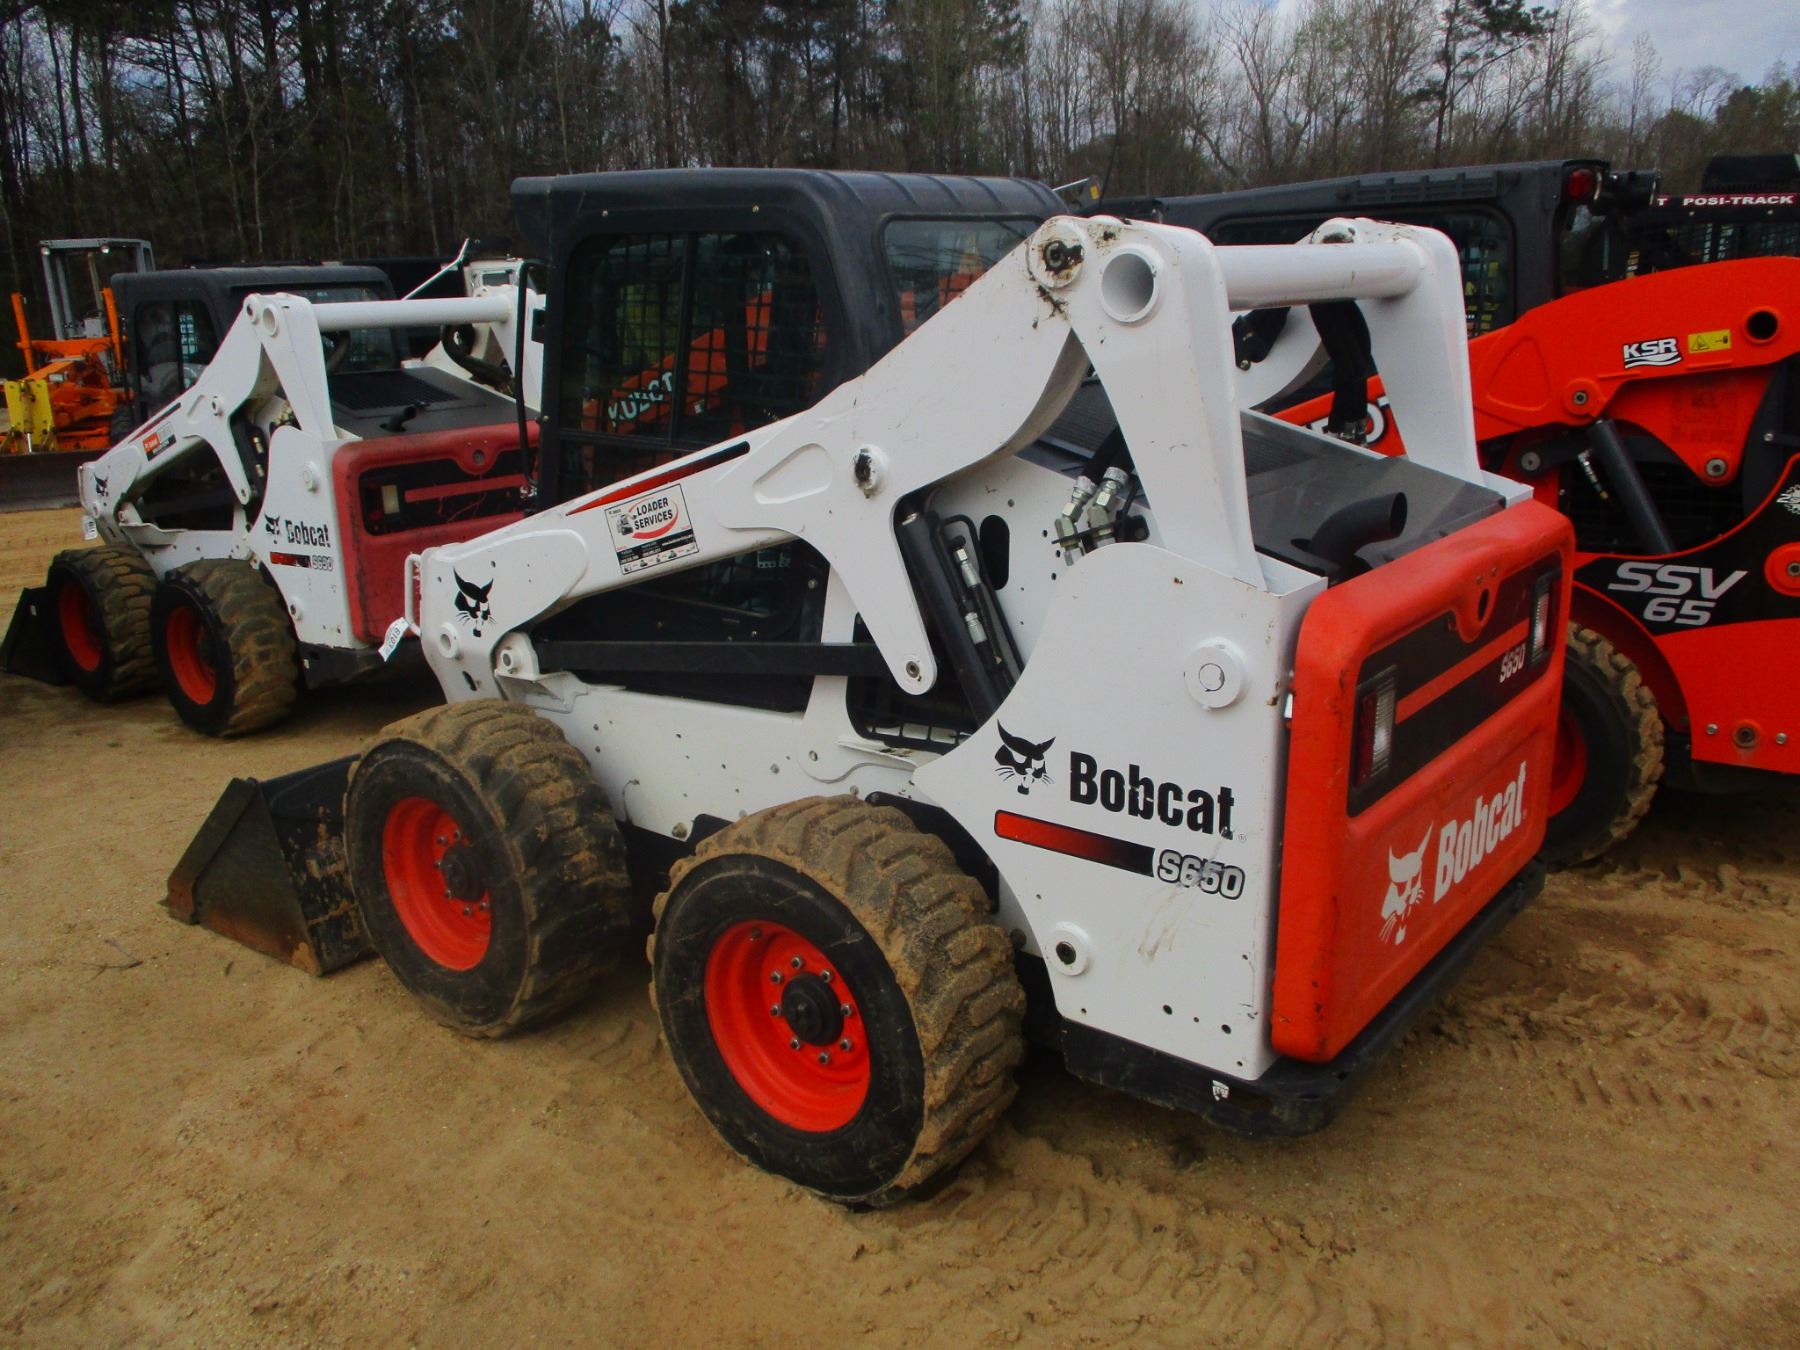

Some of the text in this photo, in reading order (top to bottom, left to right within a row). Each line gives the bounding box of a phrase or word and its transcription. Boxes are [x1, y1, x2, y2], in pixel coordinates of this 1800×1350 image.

[1682, 195, 1794, 206] POSI-TRACK
[1623, 338, 1677, 359] KSR
[634, 509, 673, 530] SERVICES
[636, 497, 669, 516] LOADER
[1607, 561, 1748, 599] SSV
[1643, 597, 1716, 626] 65
[1499, 642, 1526, 683] S650
[1070, 750, 1235, 841] Bobcat
[1433, 760, 1527, 904] Bobcat
[1157, 849, 1246, 900] S650
